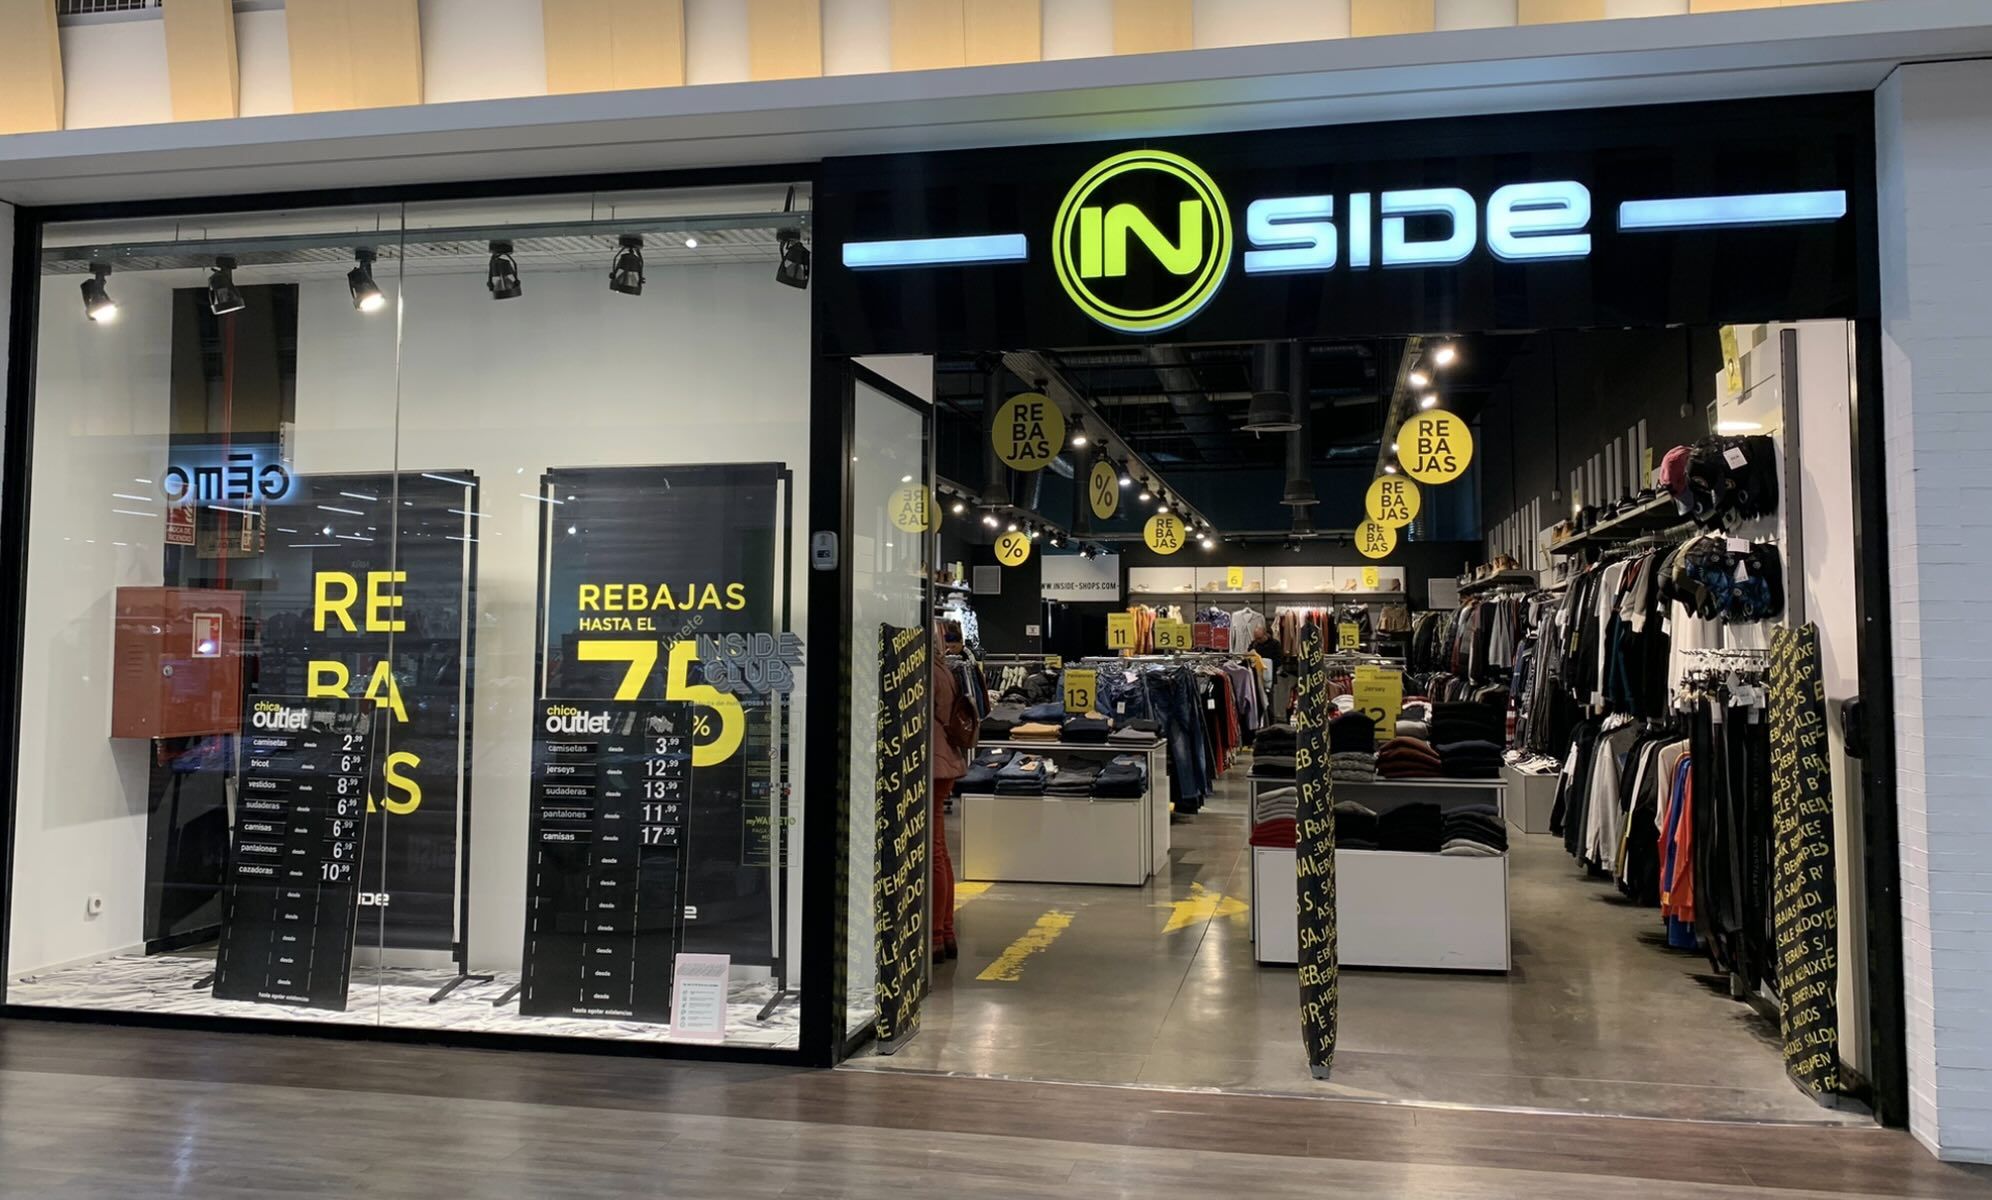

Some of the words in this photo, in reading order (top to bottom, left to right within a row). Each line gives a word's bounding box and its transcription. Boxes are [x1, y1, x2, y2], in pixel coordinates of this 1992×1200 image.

[1013, 404, 1044, 422] RE
[1012, 423, 1045, 440] BA
[1419, 420, 1449, 437] RE
[1006, 441, 1050, 460] JAS
[1417, 438, 1451, 455] BA
[1412, 456, 1457, 473] JAS
[1382, 481, 1404, 494] RE
[1381, 494, 1405, 507] BA
[1377, 508, 1409, 521] JAS
[1156, 518, 1174, 529] RE
[1155, 529, 1175, 539] BA
[1366, 533, 1385, 542] BA
[1152, 539, 1178, 549] JAS
[1364, 542, 1388, 553] JAS
[314, 571, 407, 632] RE
[578, 583, 746, 611] REBAJAS
[579, 617, 632, 631] HASTA
[637, 617, 656, 631] EL
[1114, 629, 1126, 645] 11
[1160, 632, 1170, 645] 8
[1176, 636, 1185, 647] 8
[1341, 635, 1355, 648] 15
[695, 632, 804, 665] INSIDE
[703, 659, 794, 693] CLUB
[577, 640, 746, 767] 75
[1067, 688, 1089, 708] 13
[254, 701, 280, 712] chica
[547, 705, 576, 716] chico
[252, 707, 308, 729] outlet
[546, 711, 611, 733] outlet
[253, 739, 288, 747] camisetas
[251, 760, 269, 768] tricot
[546, 765, 575, 774] jerseys
[248, 781, 276, 789] vestidos
[546, 787, 587, 797] sudaderas
[246, 801, 280, 810] sudaderas
[543, 810, 586, 818] pantalones
[244, 823, 272, 832] camisas
[543, 832, 575, 840] camisas
[240, 844, 277, 853] pantalones
[239, 866, 273, 875] cazadoras
